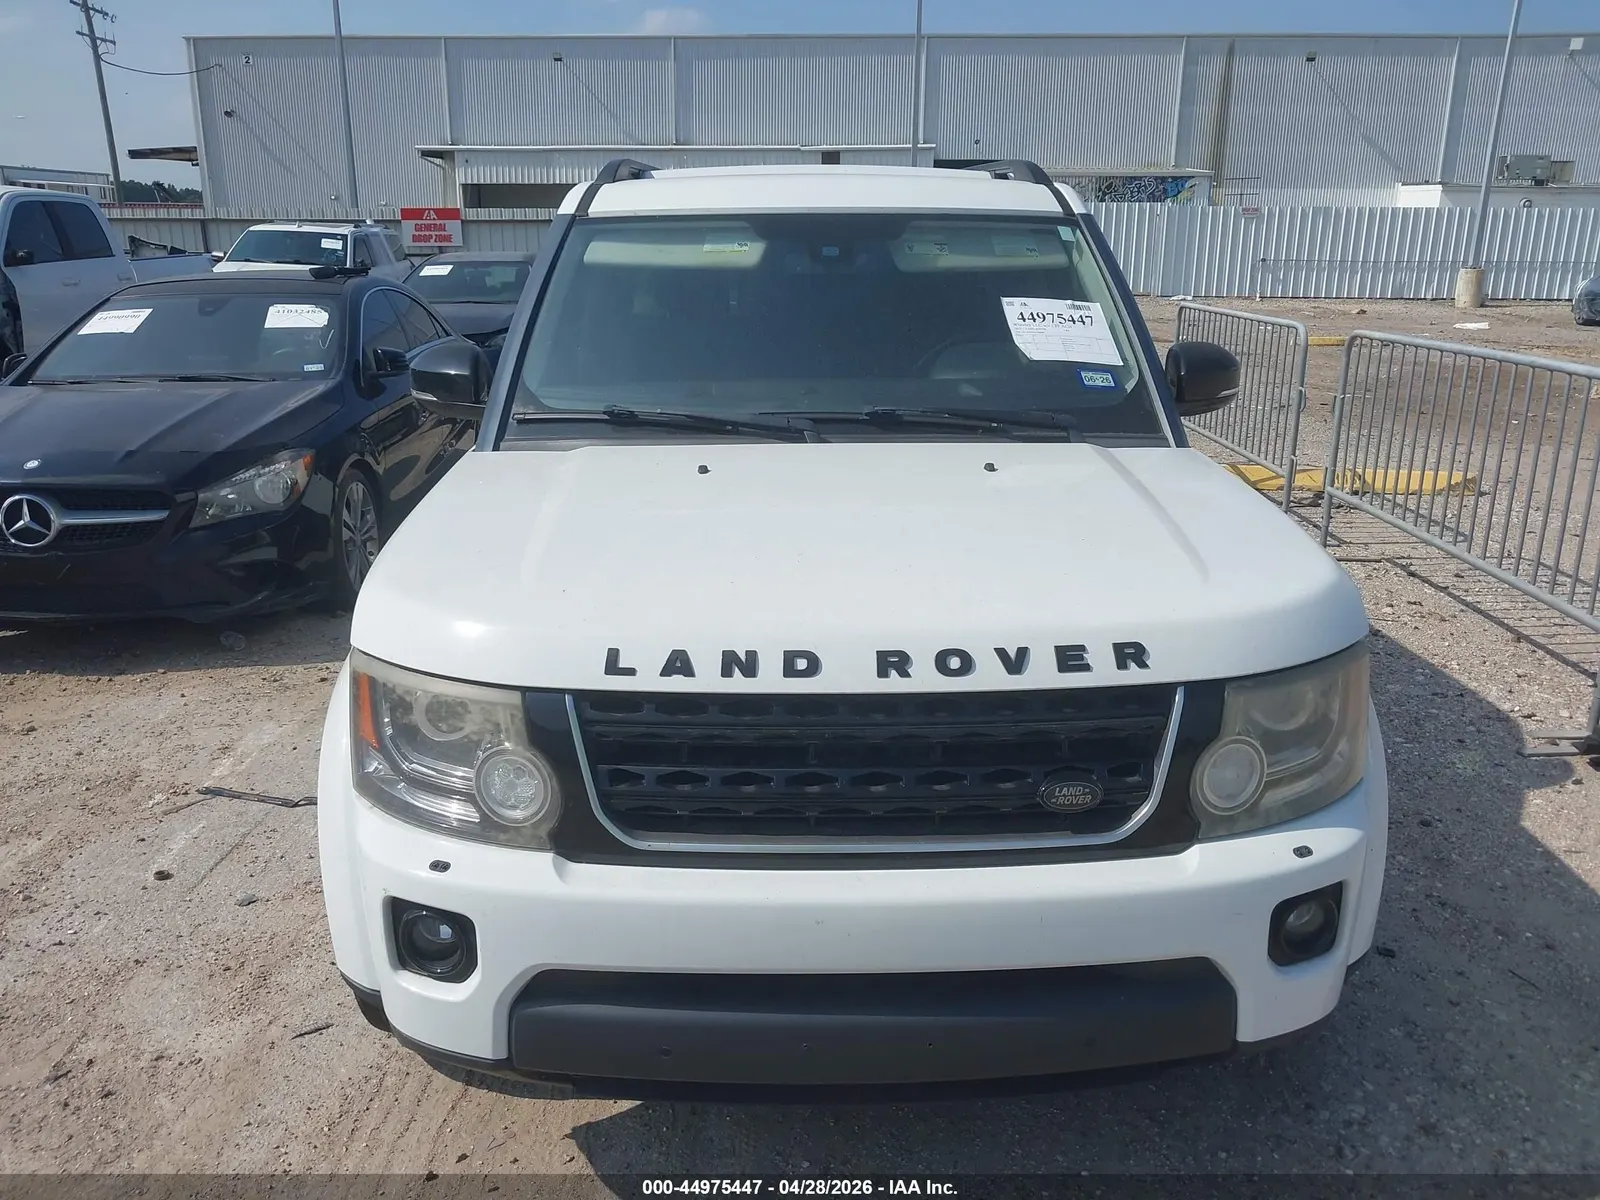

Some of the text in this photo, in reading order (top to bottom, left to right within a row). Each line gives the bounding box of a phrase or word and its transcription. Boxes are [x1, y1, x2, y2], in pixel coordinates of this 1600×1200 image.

[244, 55, 251, 64] 2
[415, 223, 447, 232] GENERAL
[412, 234, 453, 243] DROP ZONE
[1017, 311, 1093, 327] 44975447
[604, 641, 1151, 678] LAND ROVER
[1055, 787, 1083, 796] LAND
[1057, 795, 1092, 805] ROVER
